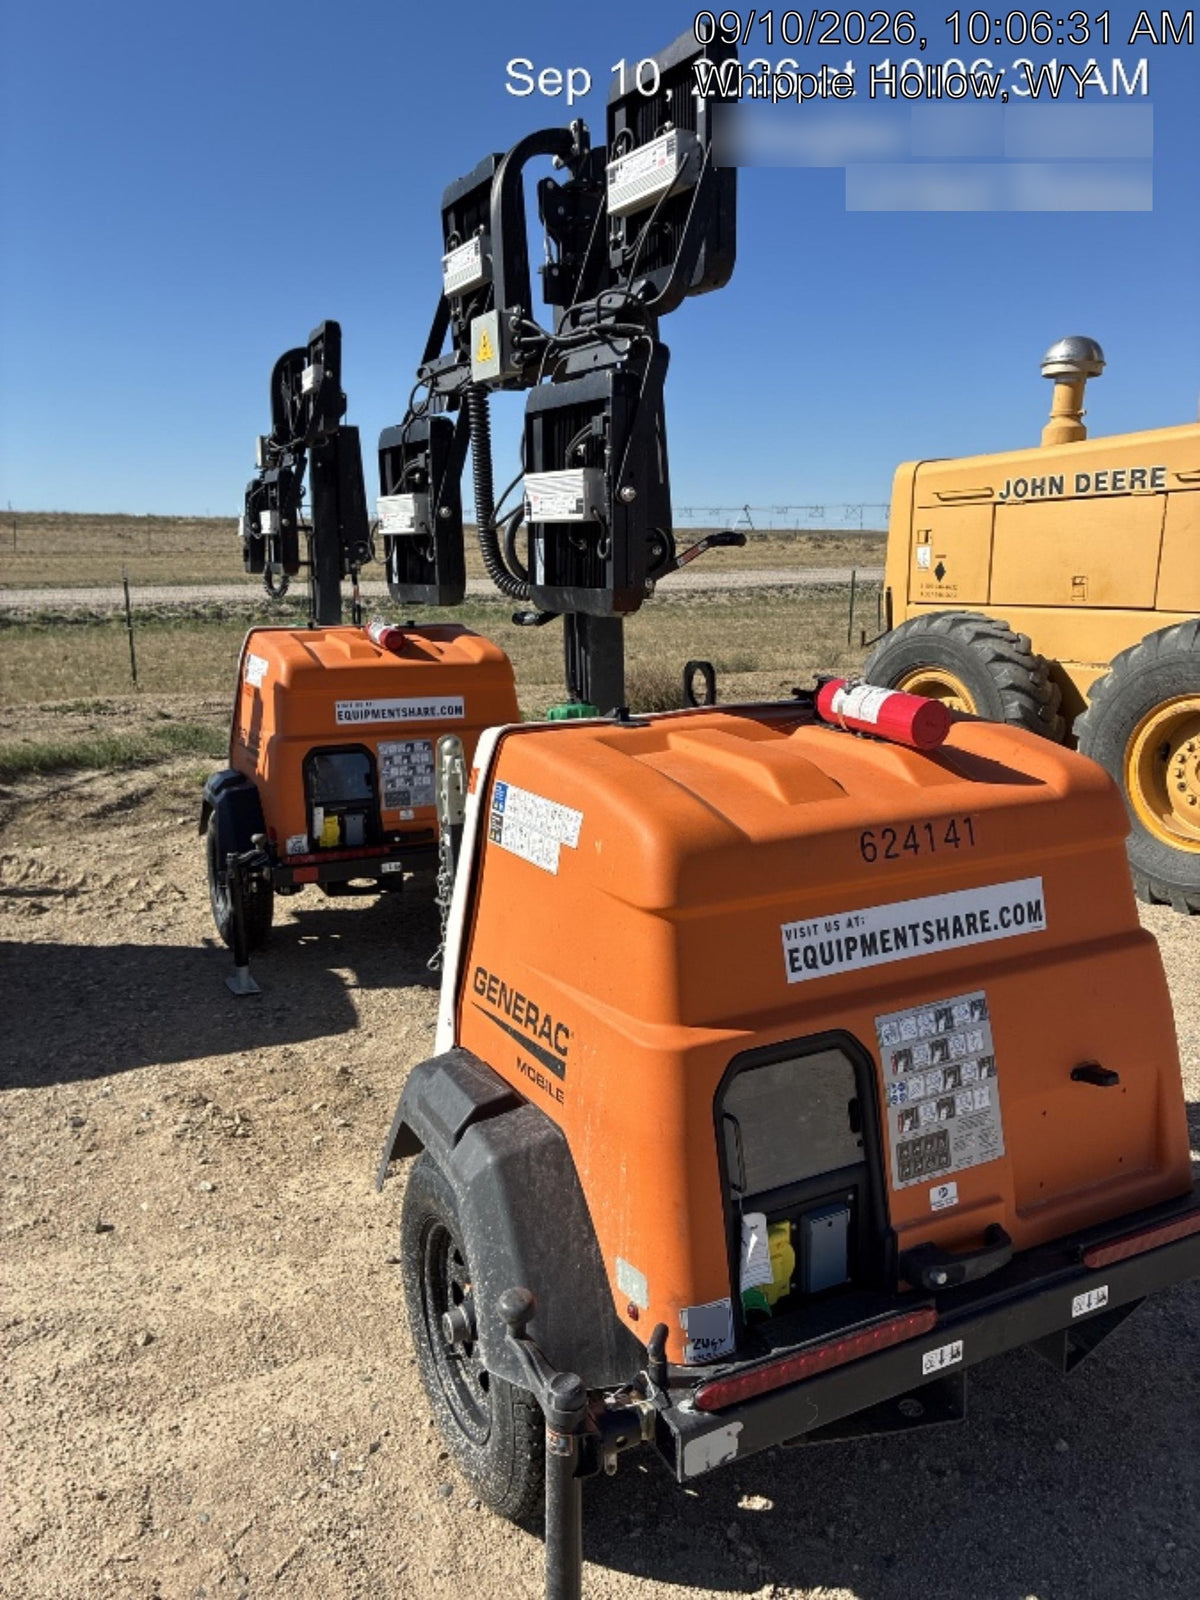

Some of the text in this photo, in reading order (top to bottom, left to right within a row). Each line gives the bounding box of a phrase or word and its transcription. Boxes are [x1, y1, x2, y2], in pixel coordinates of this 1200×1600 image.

[999, 467, 1166, 499] JOHN DEERE
[337, 706, 463, 720] EQUIPMENTSHARE.COM
[860, 817, 976, 862] 624141
[785, 924, 818, 941] VISIT
[825, 921, 840, 933] US
[788, 899, 1043, 973] EQUIPMENTSHARE.COM
[474, 967, 570, 1056] GENERAC
[516, 1056, 565, 1104] MOBILE
